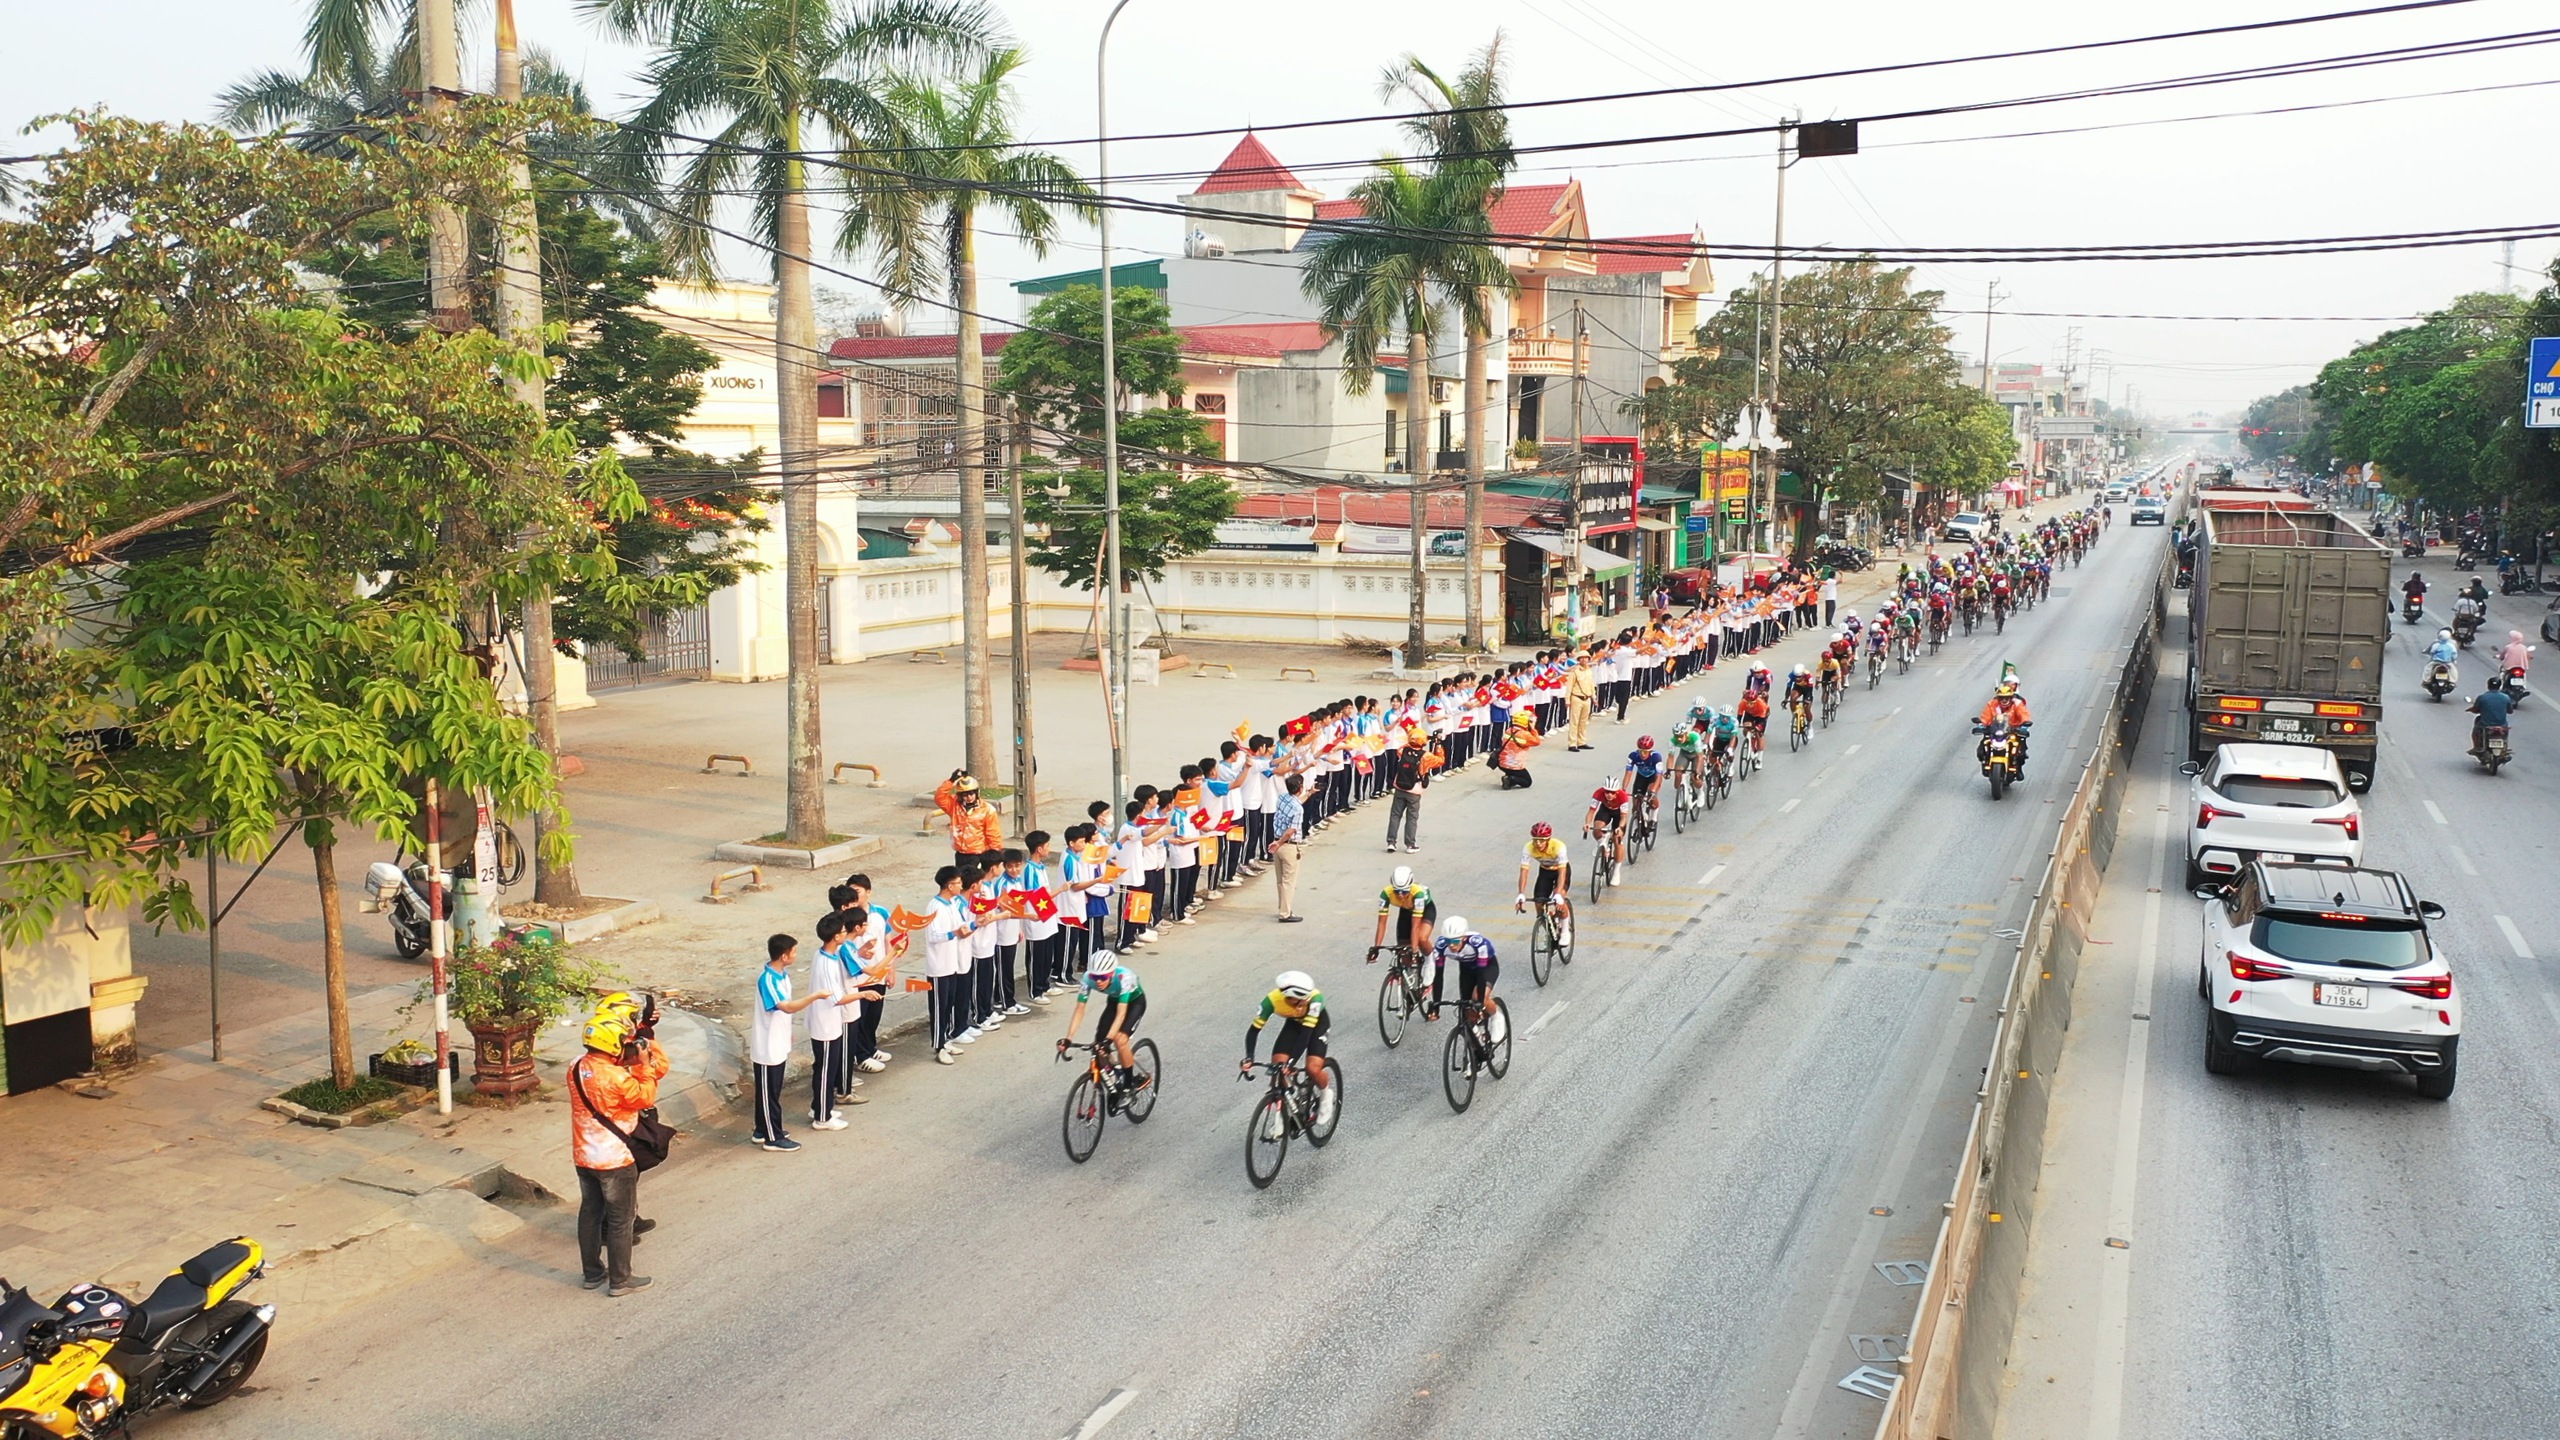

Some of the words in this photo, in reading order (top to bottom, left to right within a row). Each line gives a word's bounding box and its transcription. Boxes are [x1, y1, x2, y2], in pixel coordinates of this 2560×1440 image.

[759, 378, 764, 389] 1
[2533, 381, 2555, 396] CHỢ
[481, 867, 495, 882] 25
[2334, 986, 2354, 996] 36K
[2326, 996, 2362, 1006] 719.64
